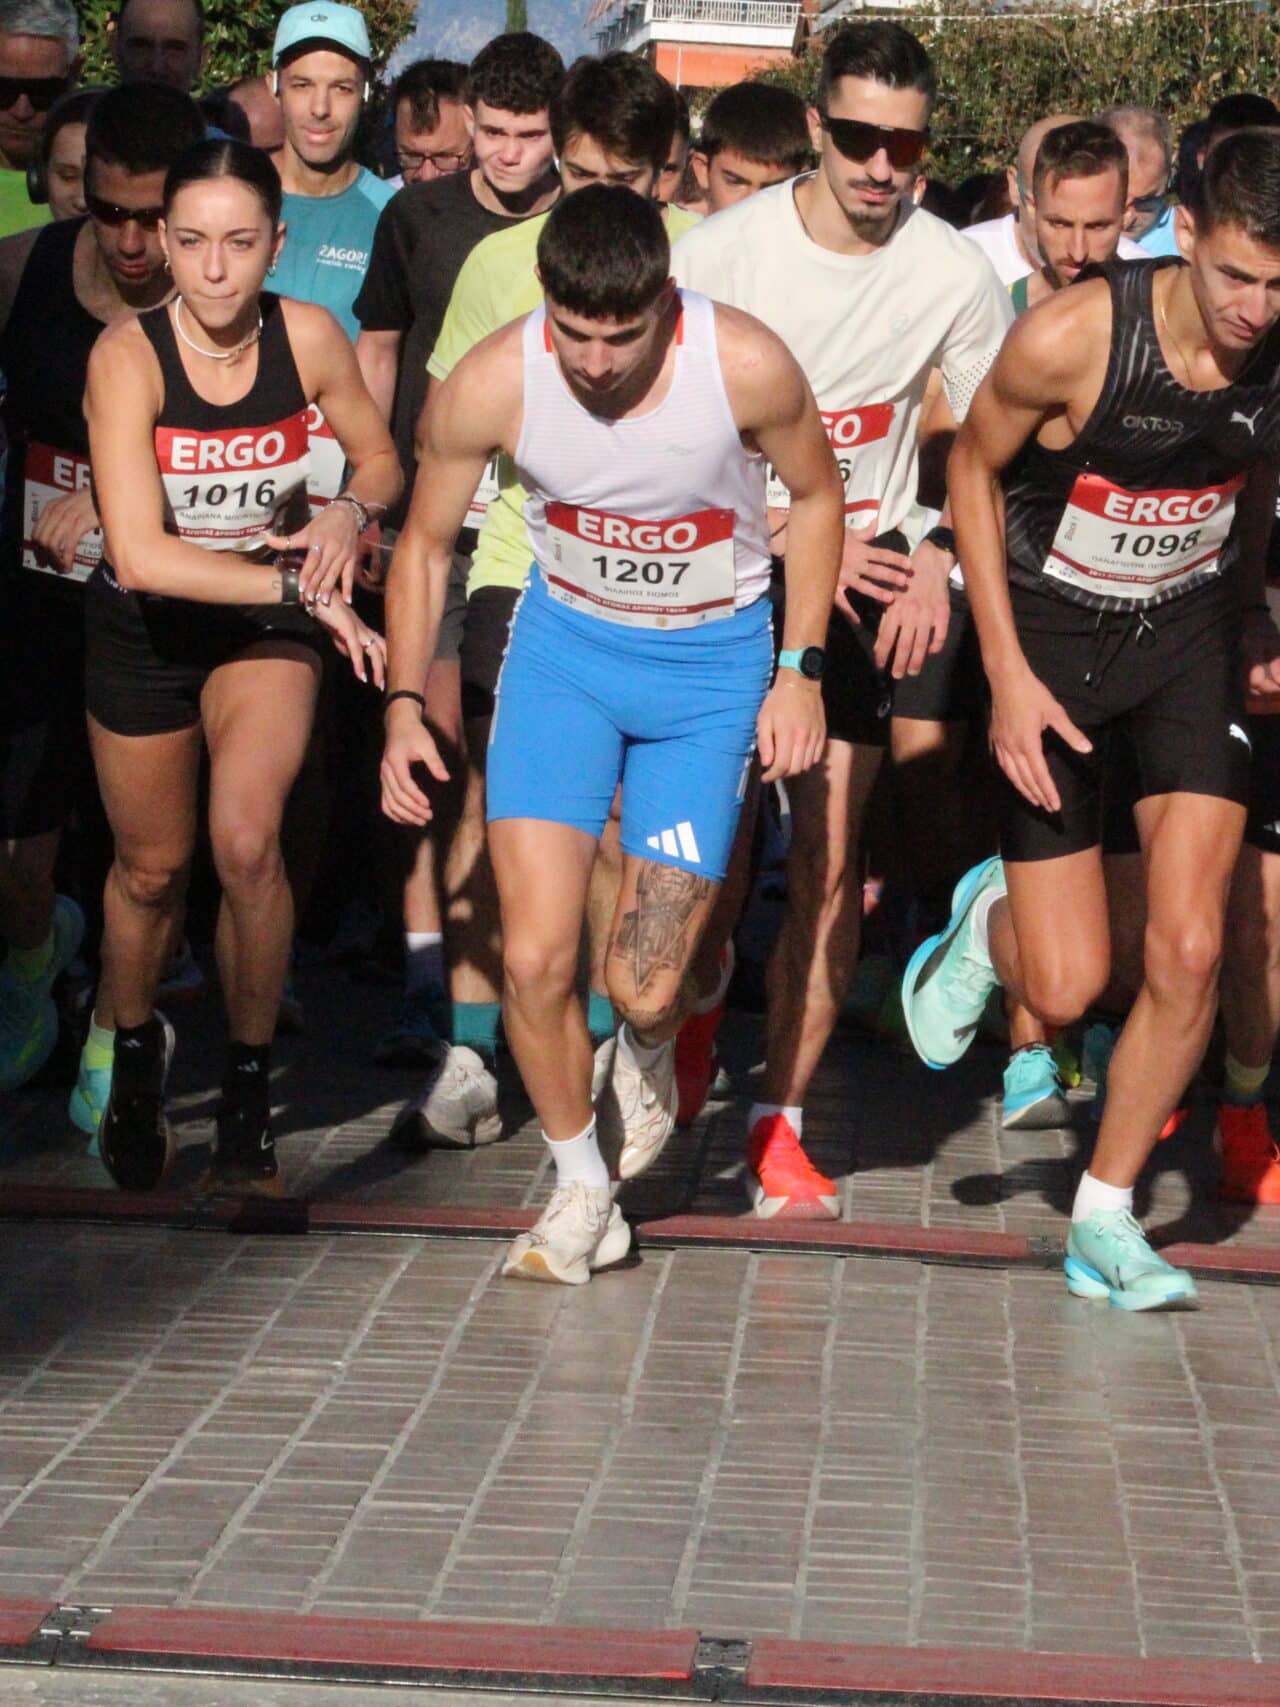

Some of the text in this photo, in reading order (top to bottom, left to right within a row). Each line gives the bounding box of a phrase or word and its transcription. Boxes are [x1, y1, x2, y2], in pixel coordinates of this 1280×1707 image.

[171, 431, 285, 470] ERGO
[183, 479, 276, 508] 1016
[1103, 491, 1221, 523] ERGO
[577, 510, 698, 551] ERGO
[1110, 529, 1202, 557] 1098
[592, 555, 691, 585] 1207
